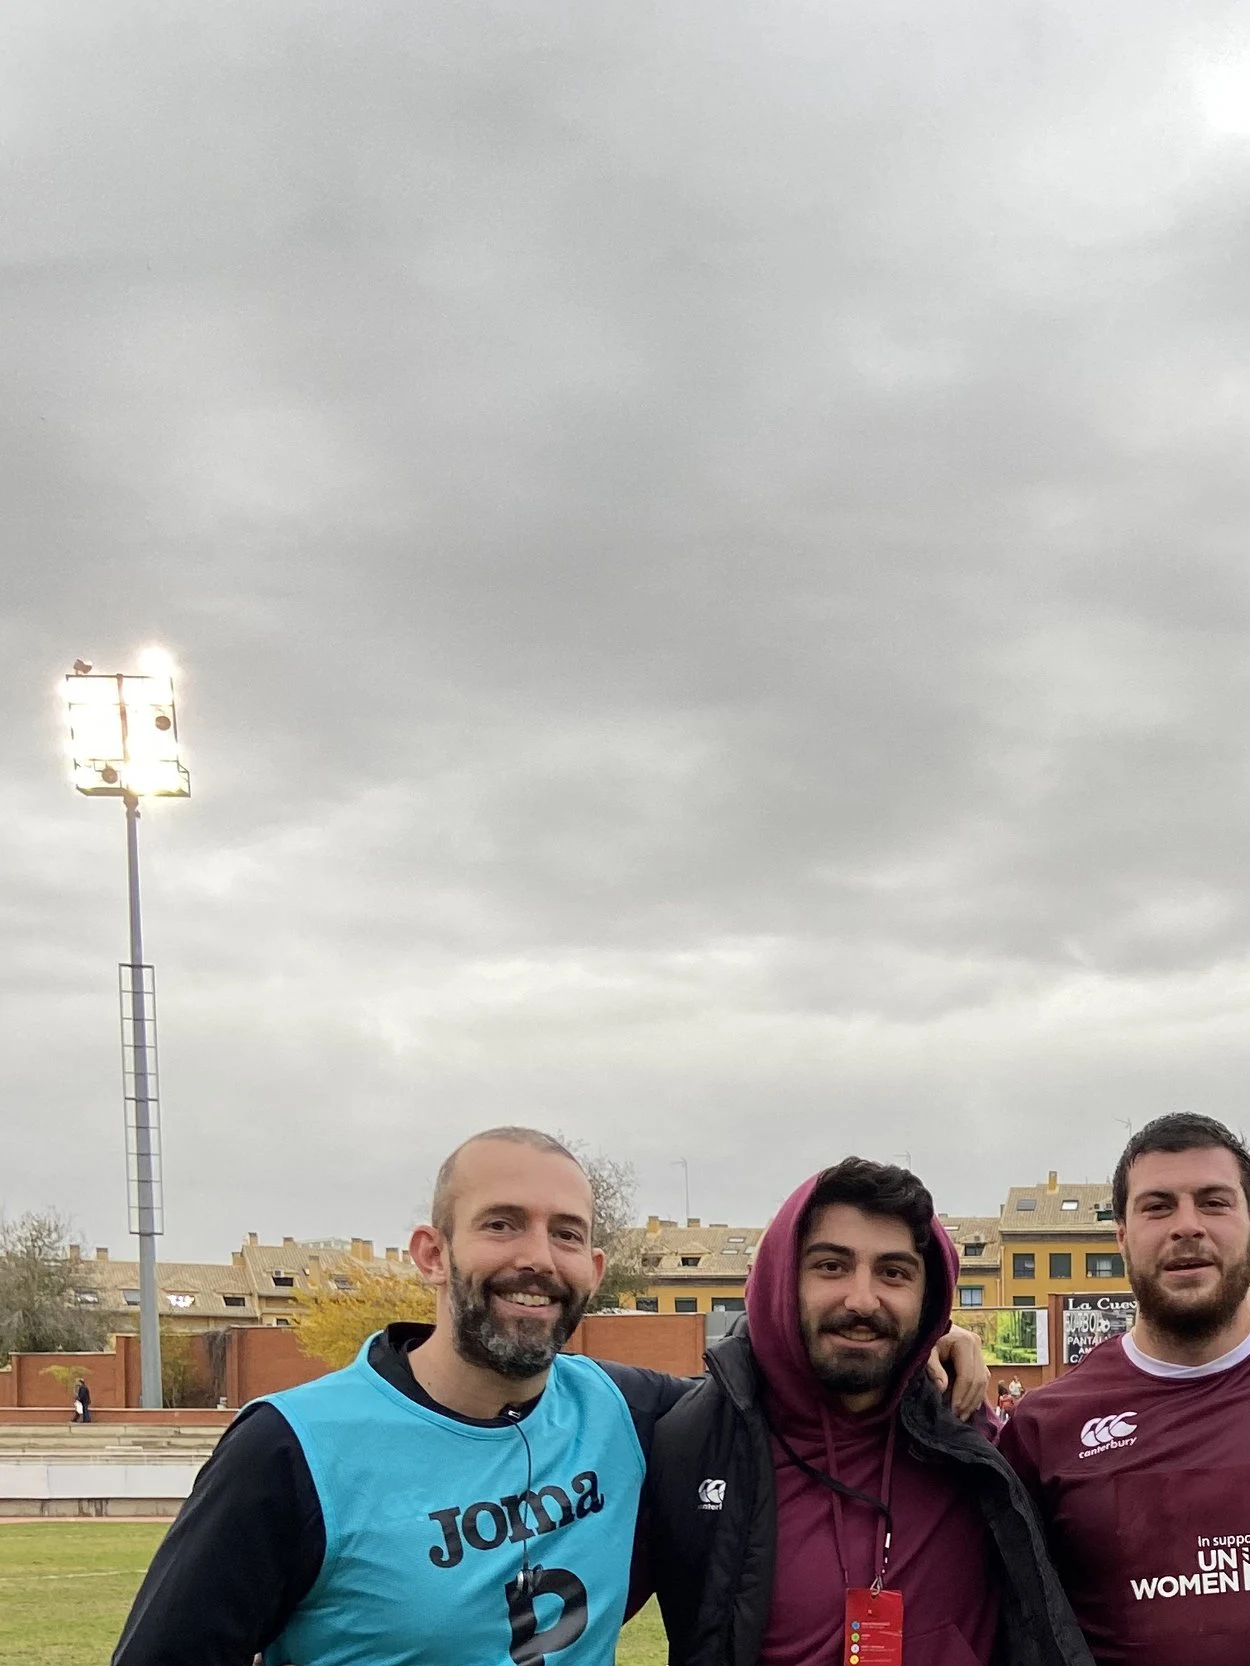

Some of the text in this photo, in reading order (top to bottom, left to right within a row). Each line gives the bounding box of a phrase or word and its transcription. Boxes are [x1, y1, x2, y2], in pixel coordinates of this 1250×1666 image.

[1067, 1298, 1092, 1311] La
[1078, 1436, 1138, 1459] canterbury
[1198, 1536, 1210, 1547] In
[1197, 1547, 1238, 1572] UN
[1130, 1570, 1240, 1600] WOMEN
